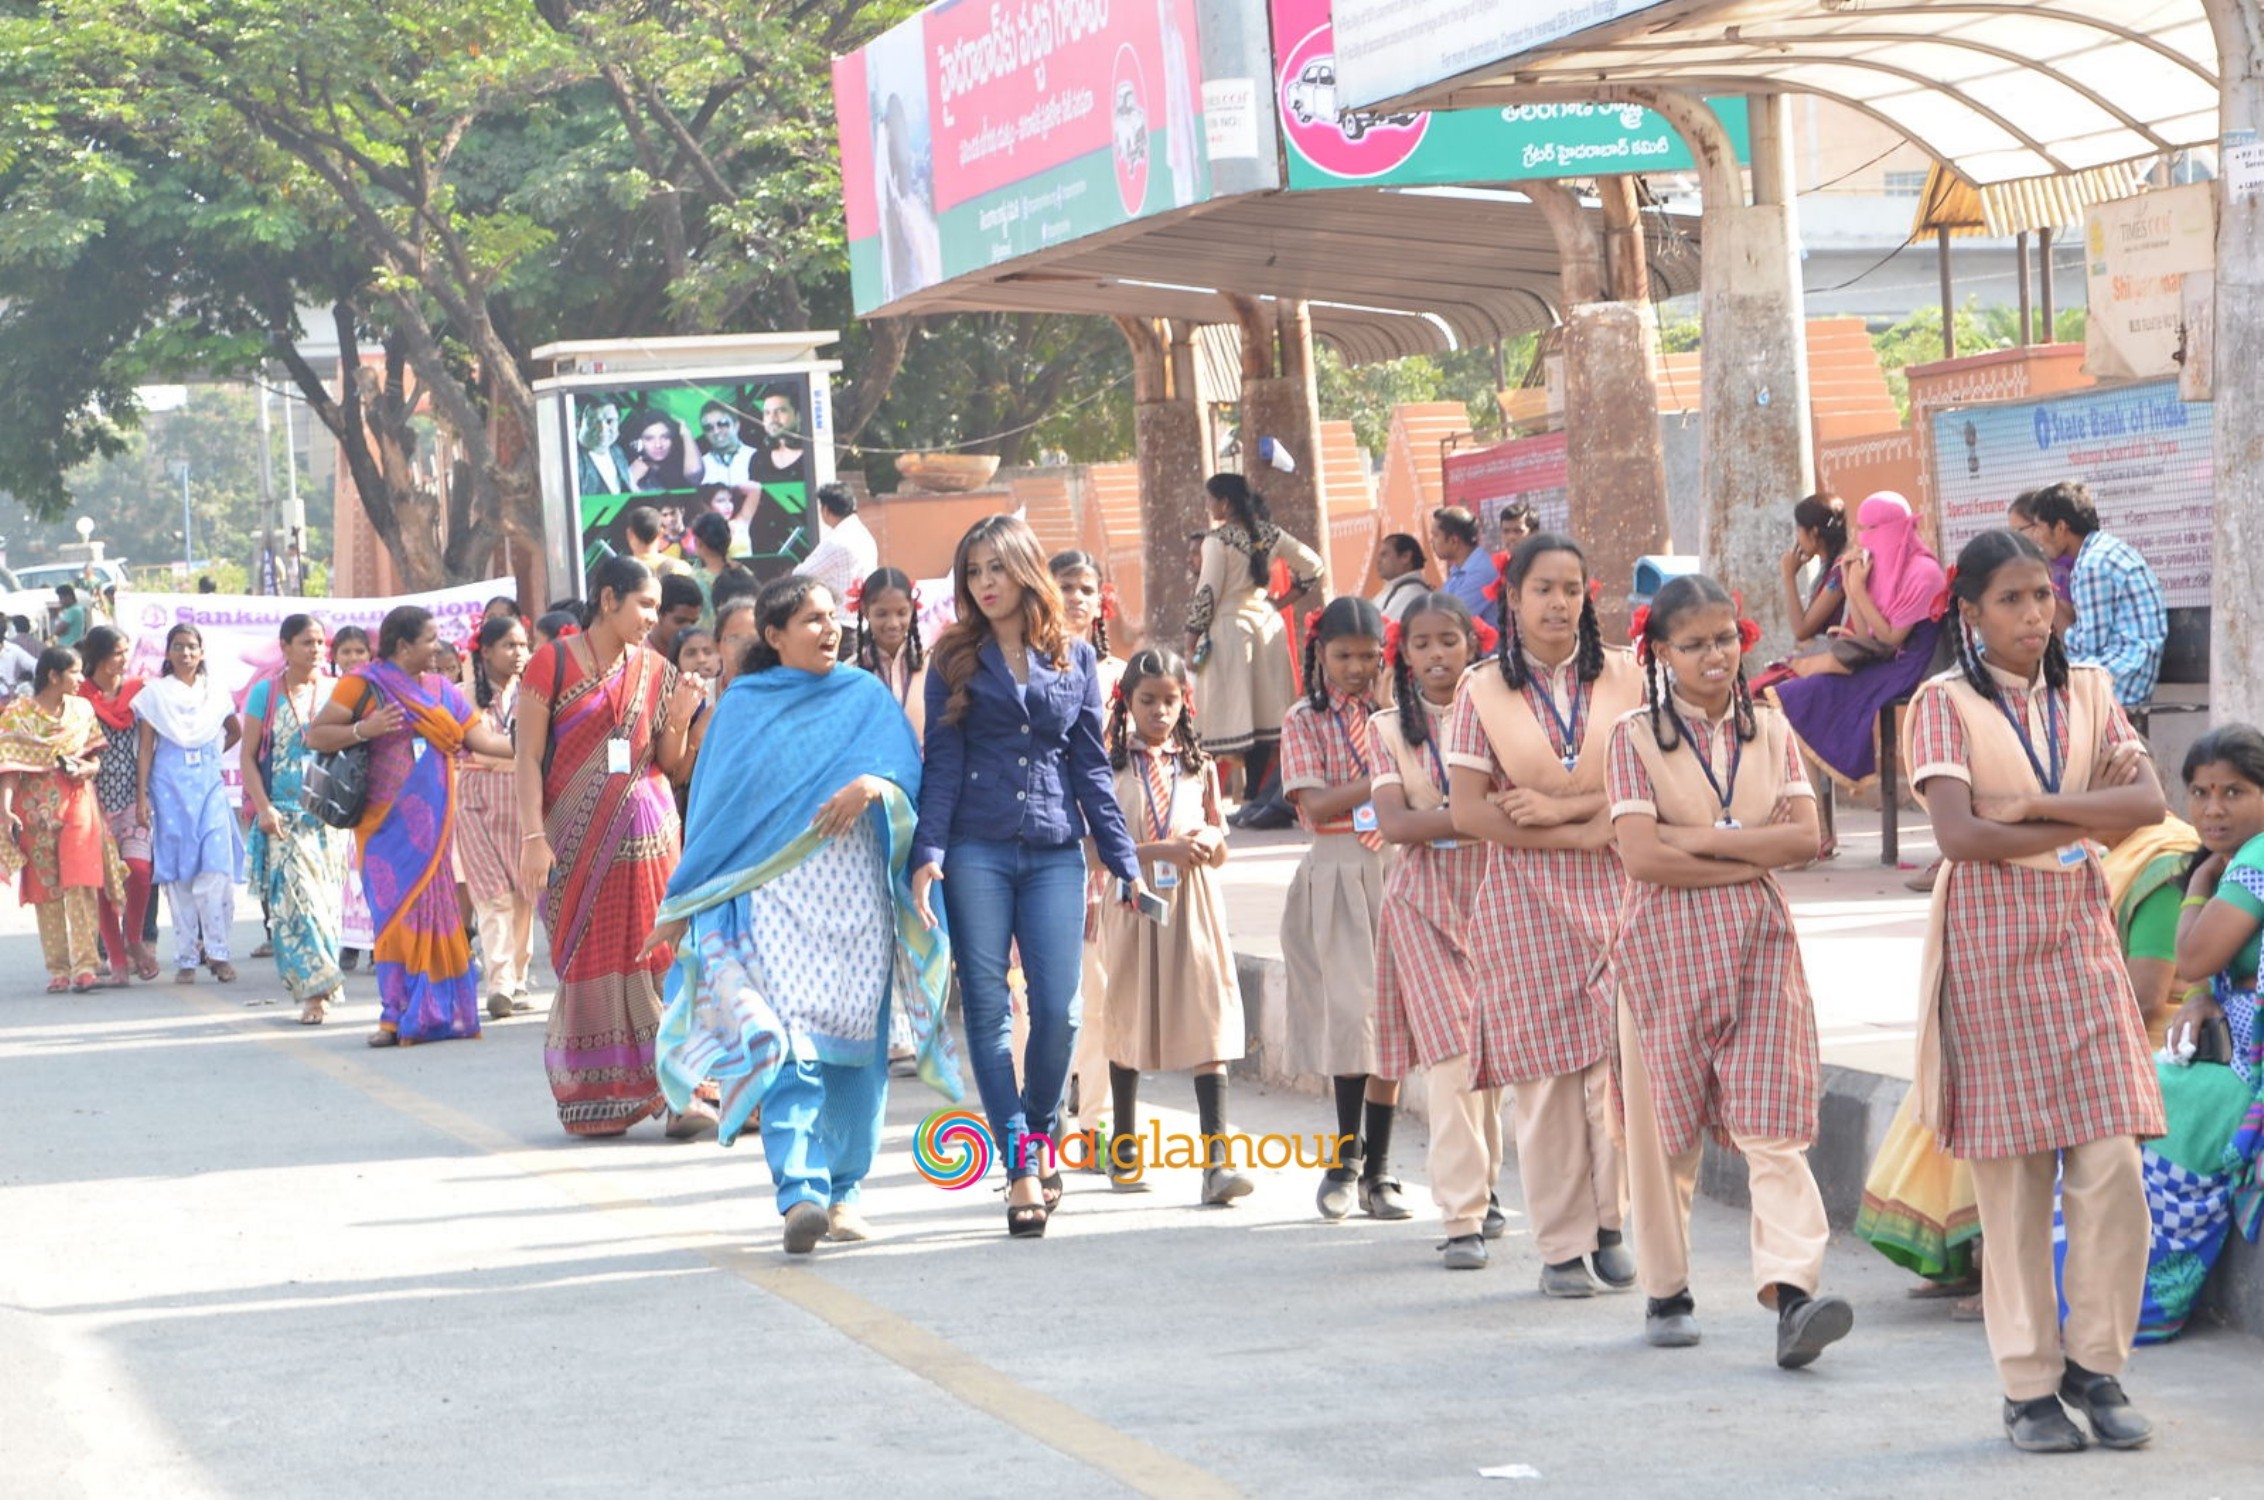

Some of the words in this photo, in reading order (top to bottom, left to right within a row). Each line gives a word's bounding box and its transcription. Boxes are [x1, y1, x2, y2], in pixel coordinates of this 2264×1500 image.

[2052, 410, 2086, 443] State
[2090, 402, 2126, 438] Bank
[2130, 400, 2145, 432] of
[2148, 398, 2188, 430] India
